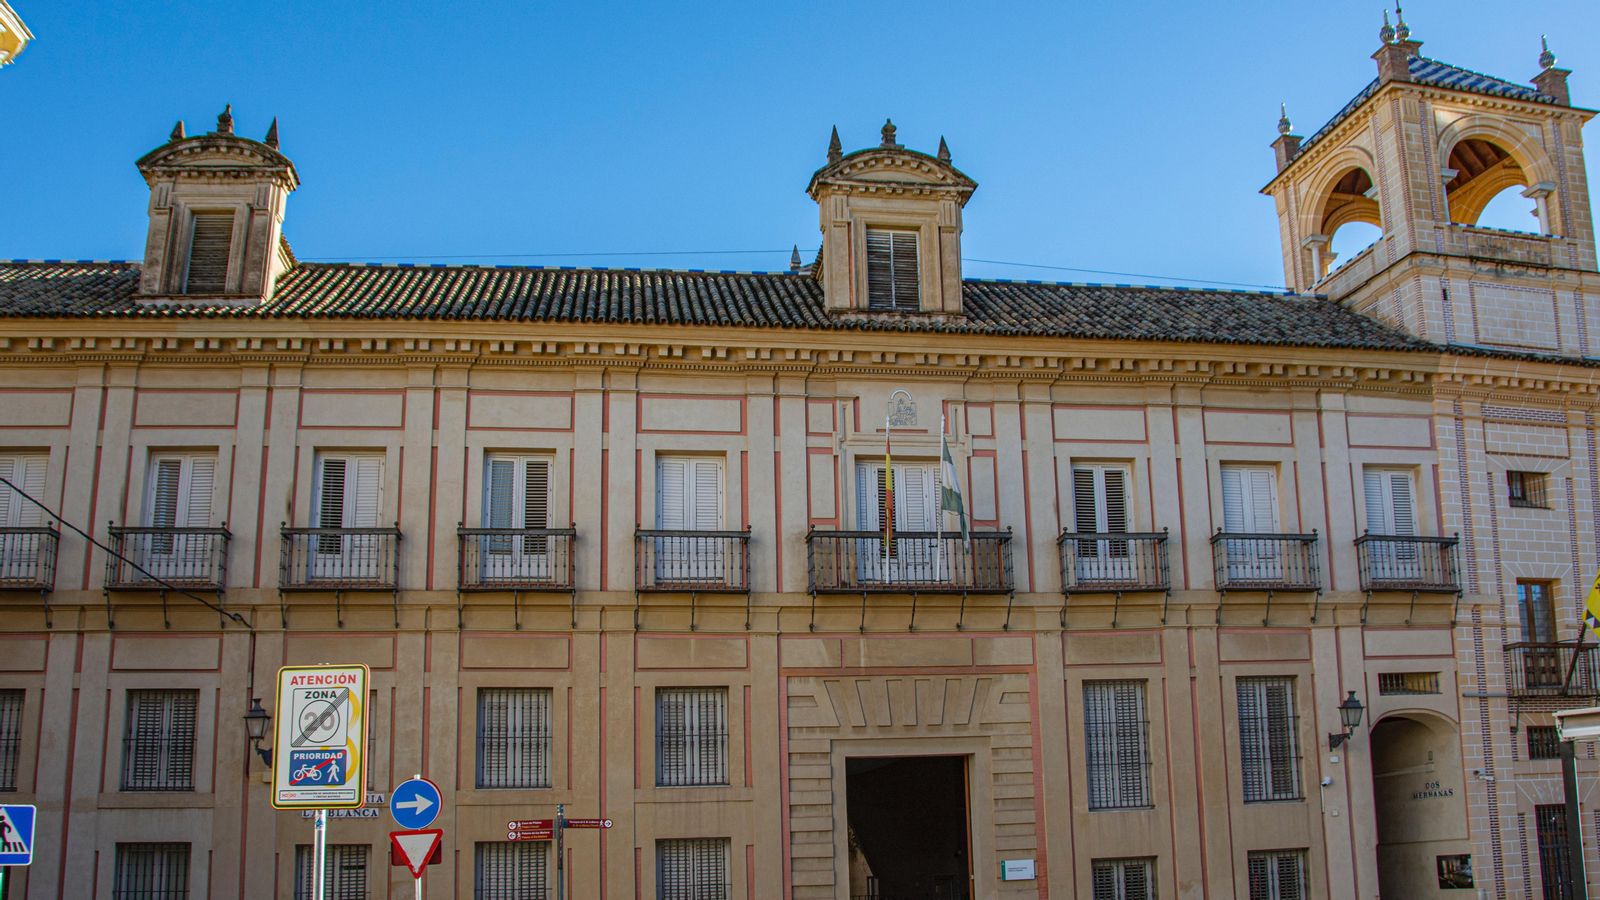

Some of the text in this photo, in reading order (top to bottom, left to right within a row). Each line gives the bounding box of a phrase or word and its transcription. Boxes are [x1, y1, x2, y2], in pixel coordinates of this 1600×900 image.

[290, 672, 357, 686] ATENCIÓN
[304, 690, 337, 700] ZONA
[304, 711, 335, 731] 20
[293, 752, 343, 760] PRIORIDAD
[328, 809, 378, 817] BLANCA
